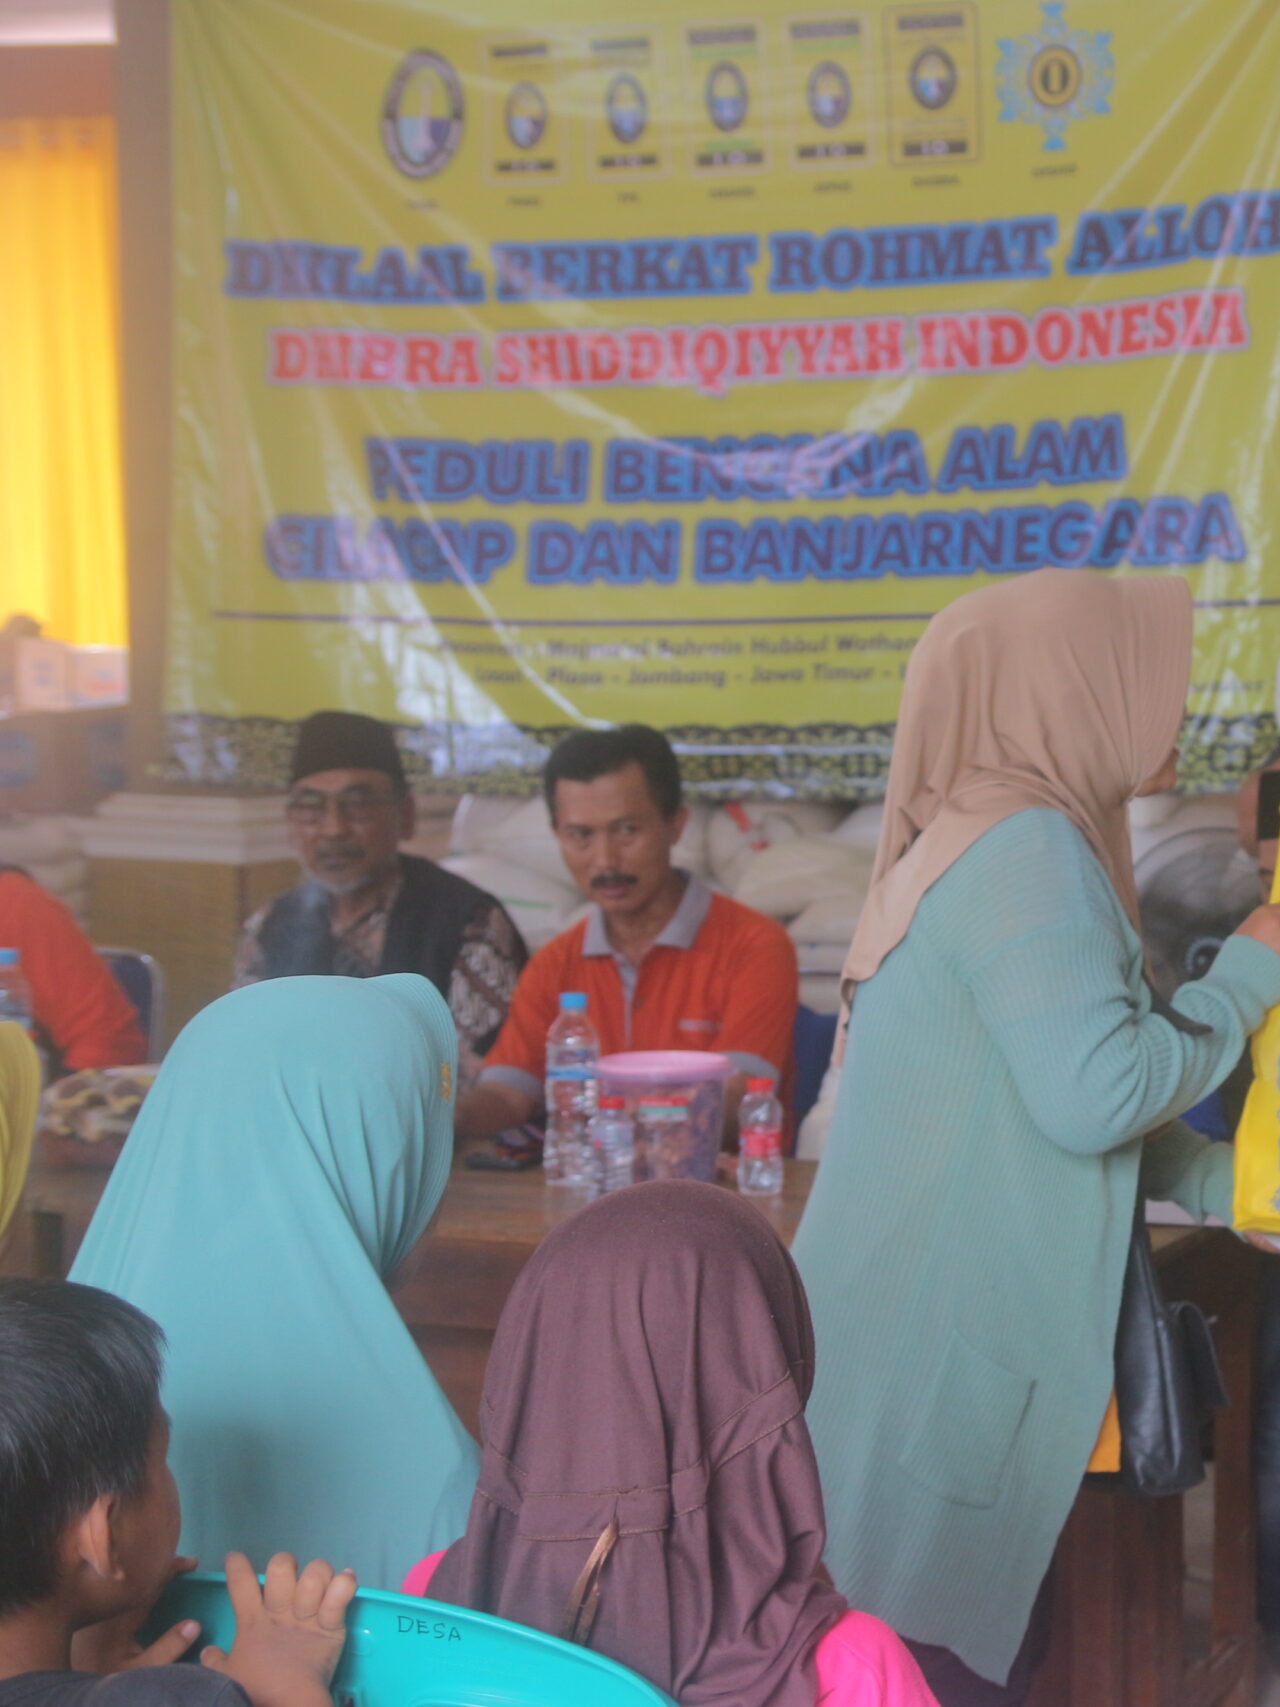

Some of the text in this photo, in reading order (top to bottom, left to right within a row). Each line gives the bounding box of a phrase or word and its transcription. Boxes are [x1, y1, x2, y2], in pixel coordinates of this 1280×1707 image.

[491, 233, 759, 301] BERKAT
[768, 215, 1057, 293] ROHMAT
[492, 316, 905, 399] SHIDDIQIYYAH
[916, 287, 1248, 375] INDONESIA
[365, 435, 590, 503] PEDULI
[936, 414, 1128, 494] ALAM
[527, 518, 681, 584] DAN
[694, 492, 1247, 583] BANJARNEGARA
[396, 1615, 462, 1642] DESA
